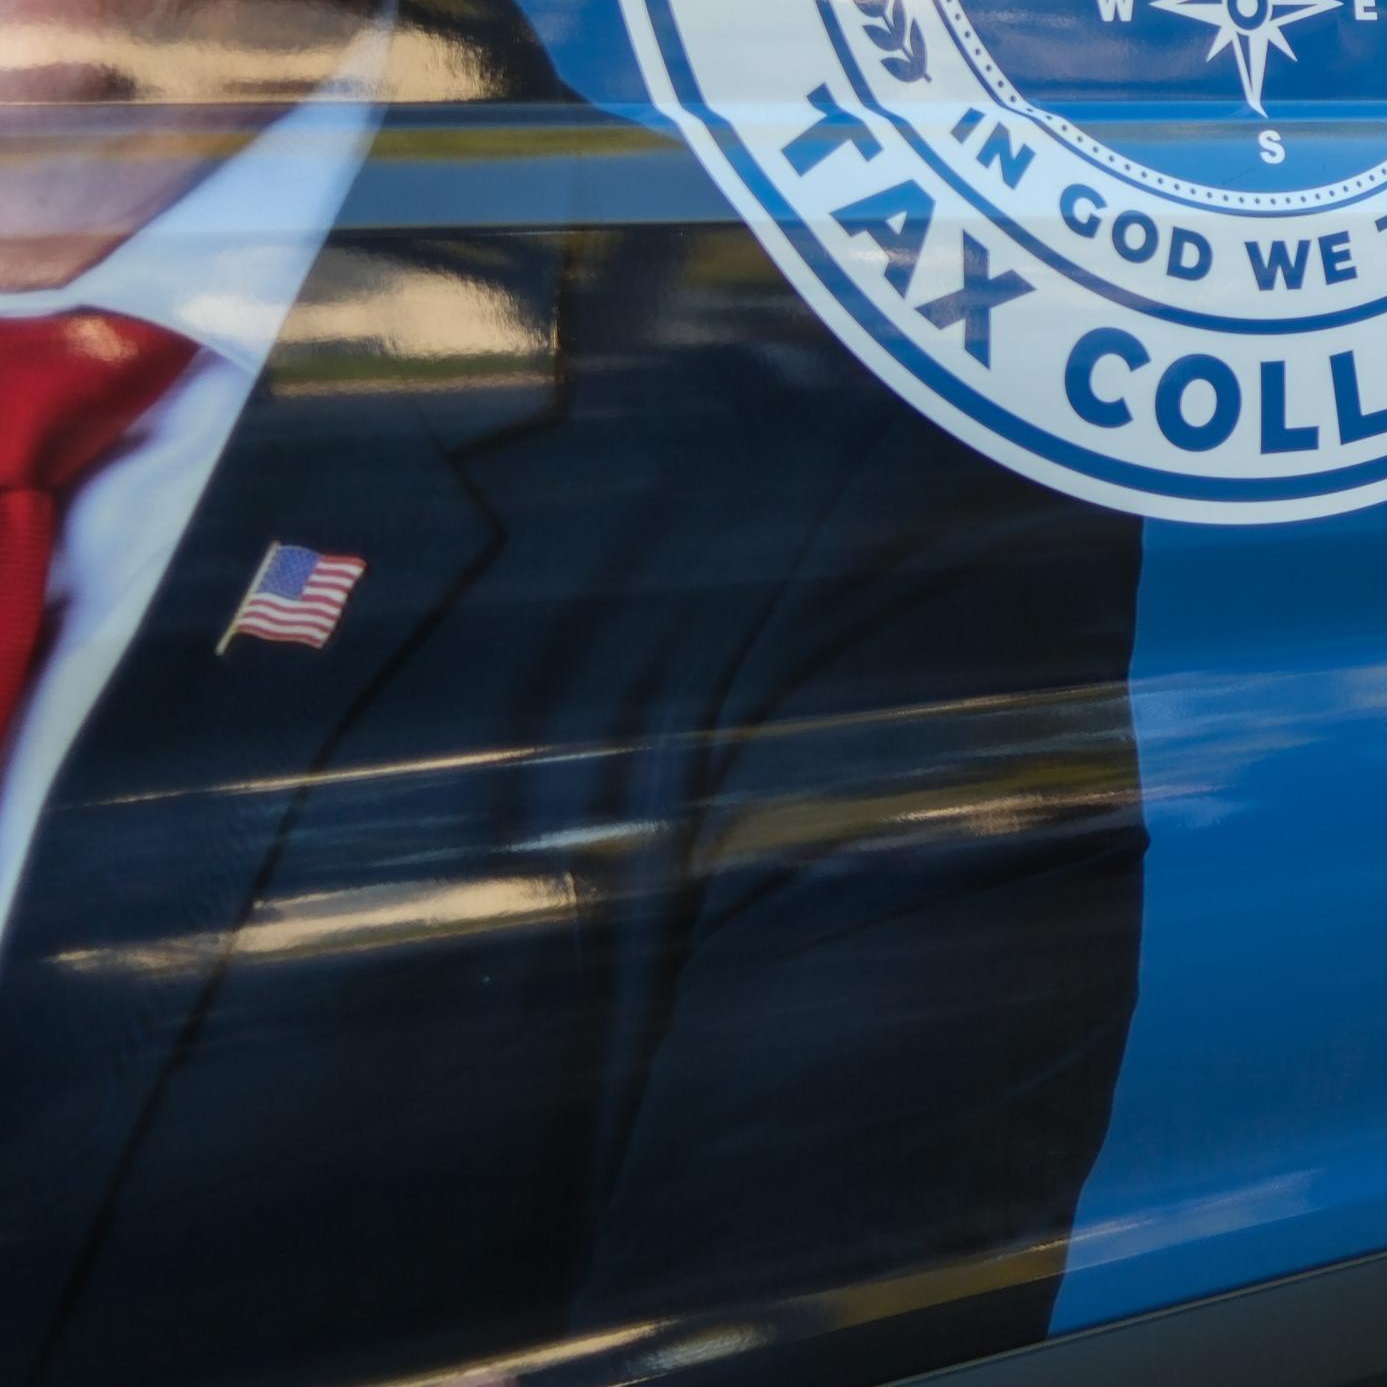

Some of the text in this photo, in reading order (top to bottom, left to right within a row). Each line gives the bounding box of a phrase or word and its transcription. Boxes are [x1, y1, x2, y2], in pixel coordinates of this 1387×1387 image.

[780, 83, 1037, 370] TAX
[950, 107, 1036, 190] IN
[1059, 184, 1213, 282] GOD
[1245, 230, 1359, 291] WE
[1258, 129, 1286, 164] S
